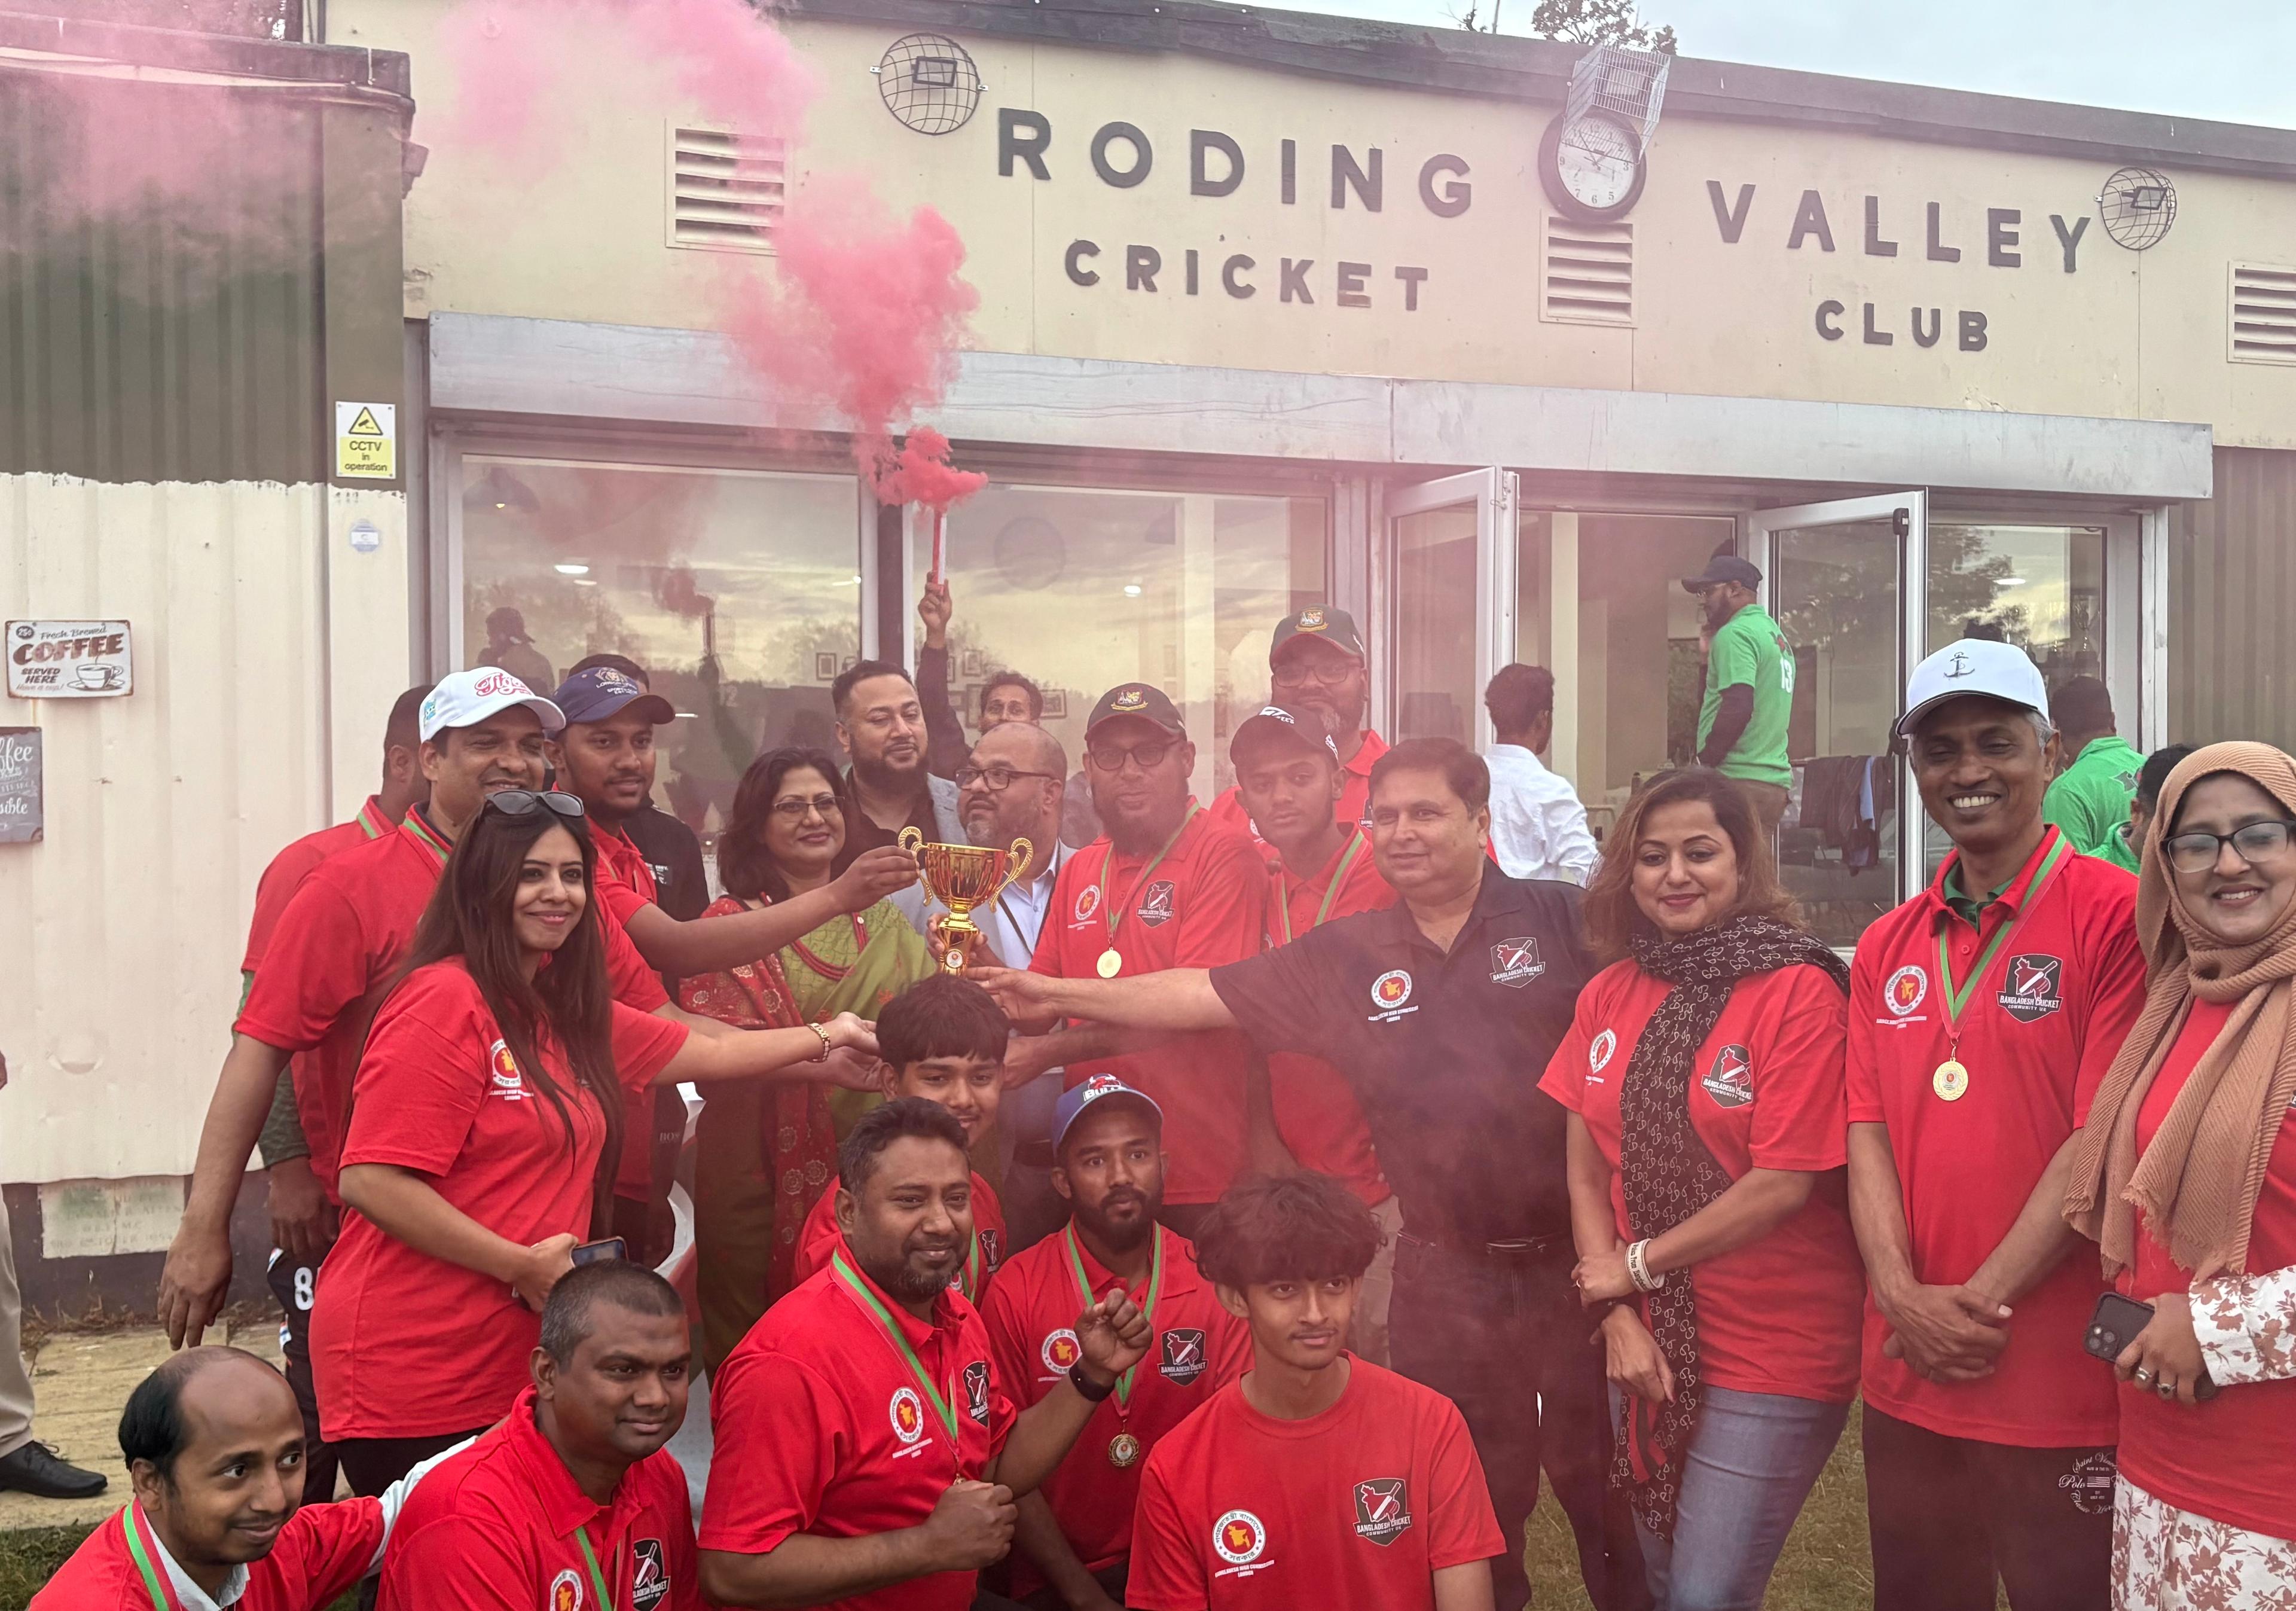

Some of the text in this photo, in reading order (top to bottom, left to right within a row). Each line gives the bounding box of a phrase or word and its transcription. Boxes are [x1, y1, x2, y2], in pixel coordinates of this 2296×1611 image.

[1559, 157, 1565, 165] 9
[1623, 161, 1629, 171] 3
[999, 108, 2090, 273] RODING VALLEY
[1575, 188, 1580, 198] 7
[1592, 195, 1598, 204] 6
[1065, 240, 1987, 351] CRICKET CLUB
[349, 441, 382, 451] CCTV
[362, 453, 371, 461] in
[344, 462, 387, 472] operation
[71, 626, 106, 637] Brewed
[13, 633, 124, 665] COFFEE
[25, 675, 59, 684] HERE
[1779, 655, 1793, 693] 13
[1492, 968, 1523, 981] BANGLADESH
[1999, 995, 2060, 1008] BANGLADESH CRICKET
[1703, 1078, 1736, 1093] BANGLADESH
[294, 1267, 315, 1310] 8
[2072, 1457, 2093, 1473] Saint
[2058, 1474, 2086, 1488] Polo
[1357, 1516, 1410, 1533] BANGLADESH CRICKET
